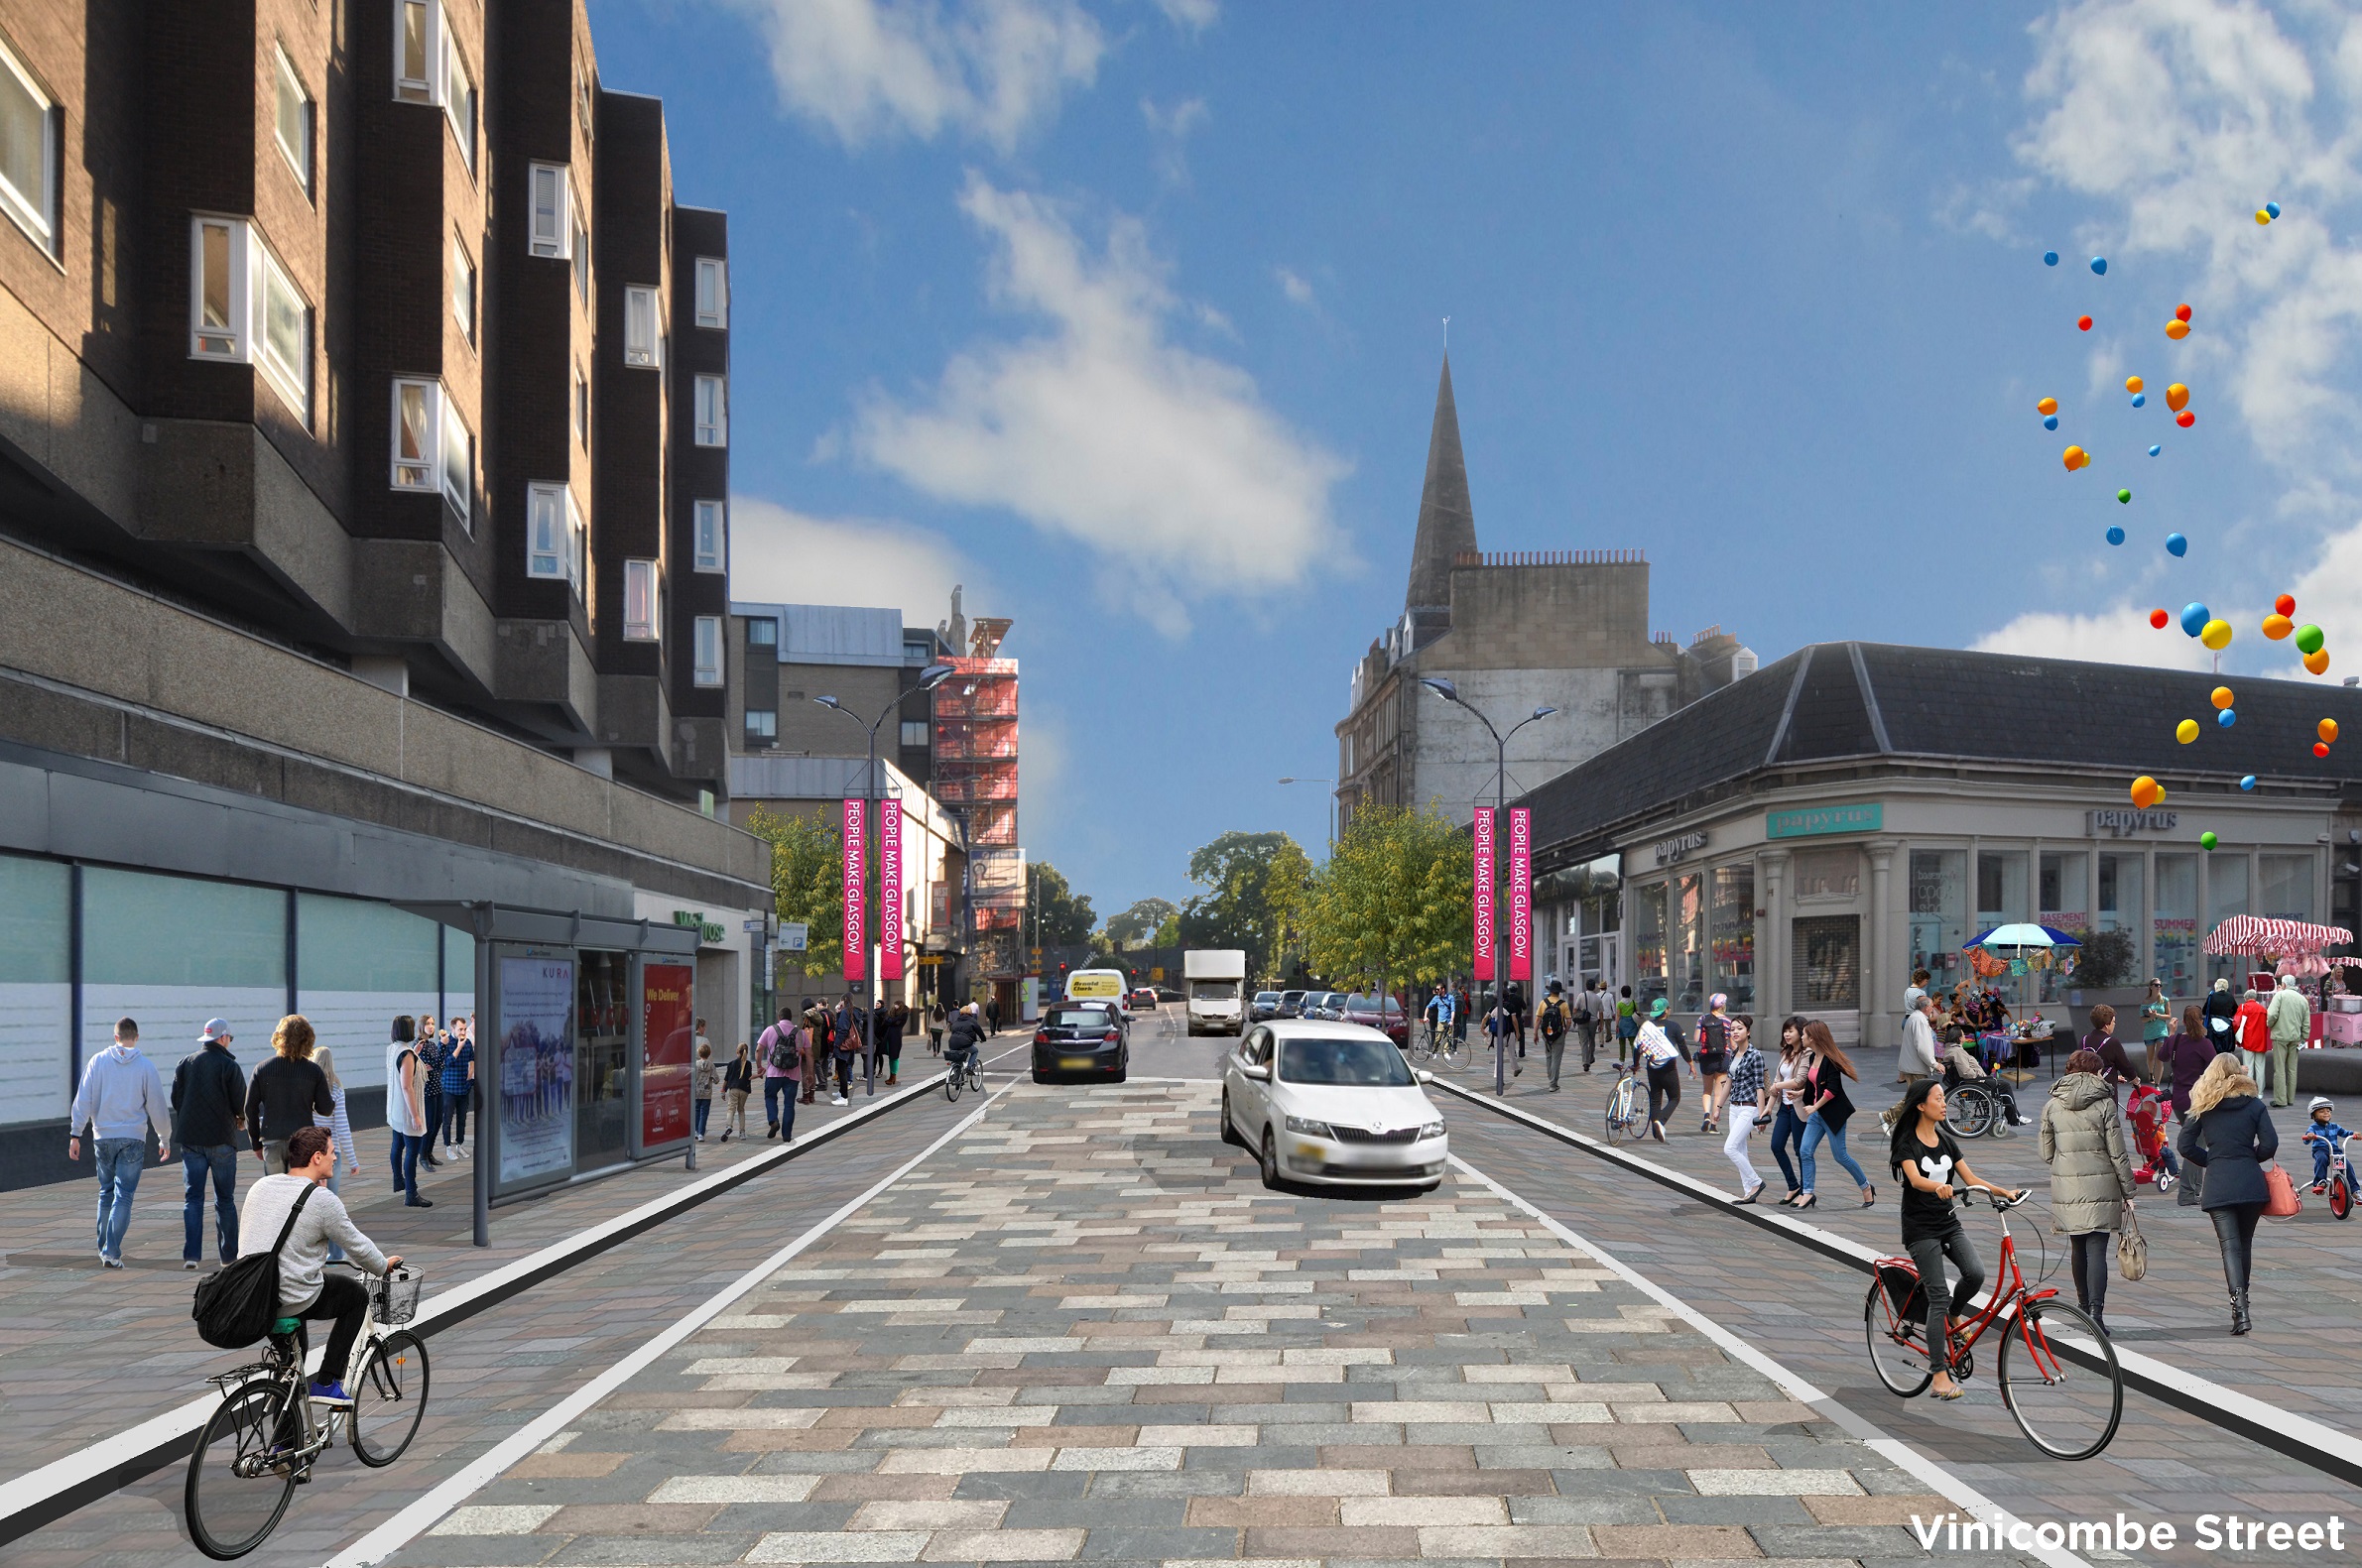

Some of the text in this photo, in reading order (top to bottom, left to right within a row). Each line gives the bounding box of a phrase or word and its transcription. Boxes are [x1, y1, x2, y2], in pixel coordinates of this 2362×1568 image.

[1777, 809, 1874, 834] papyrus
[2092, 809, 2178, 836] papyrus
[1654, 832, 1702, 867] papyrus
[847, 801, 860, 954] PEOPLE MAKE GLASGOW
[885, 801, 898, 954] PEOPLE MAKE GLASGOW
[1477, 810, 1490, 958] PEOPLE MAKE GLASGOW
[1514, 810, 1527, 959] PEOPLE MAKE GLASGOW
[932, 887, 948, 897] WEST
[933, 897, 945, 907] END
[2040, 912, 2086, 922] BASEMENT
[2154, 918, 2196, 930] SUMMER
[1638, 946, 1667, 970] SALE
[1713, 937, 1754, 963] SALE
[543, 967, 568, 979] KURA
[647, 988, 680, 1001] We Deliver
